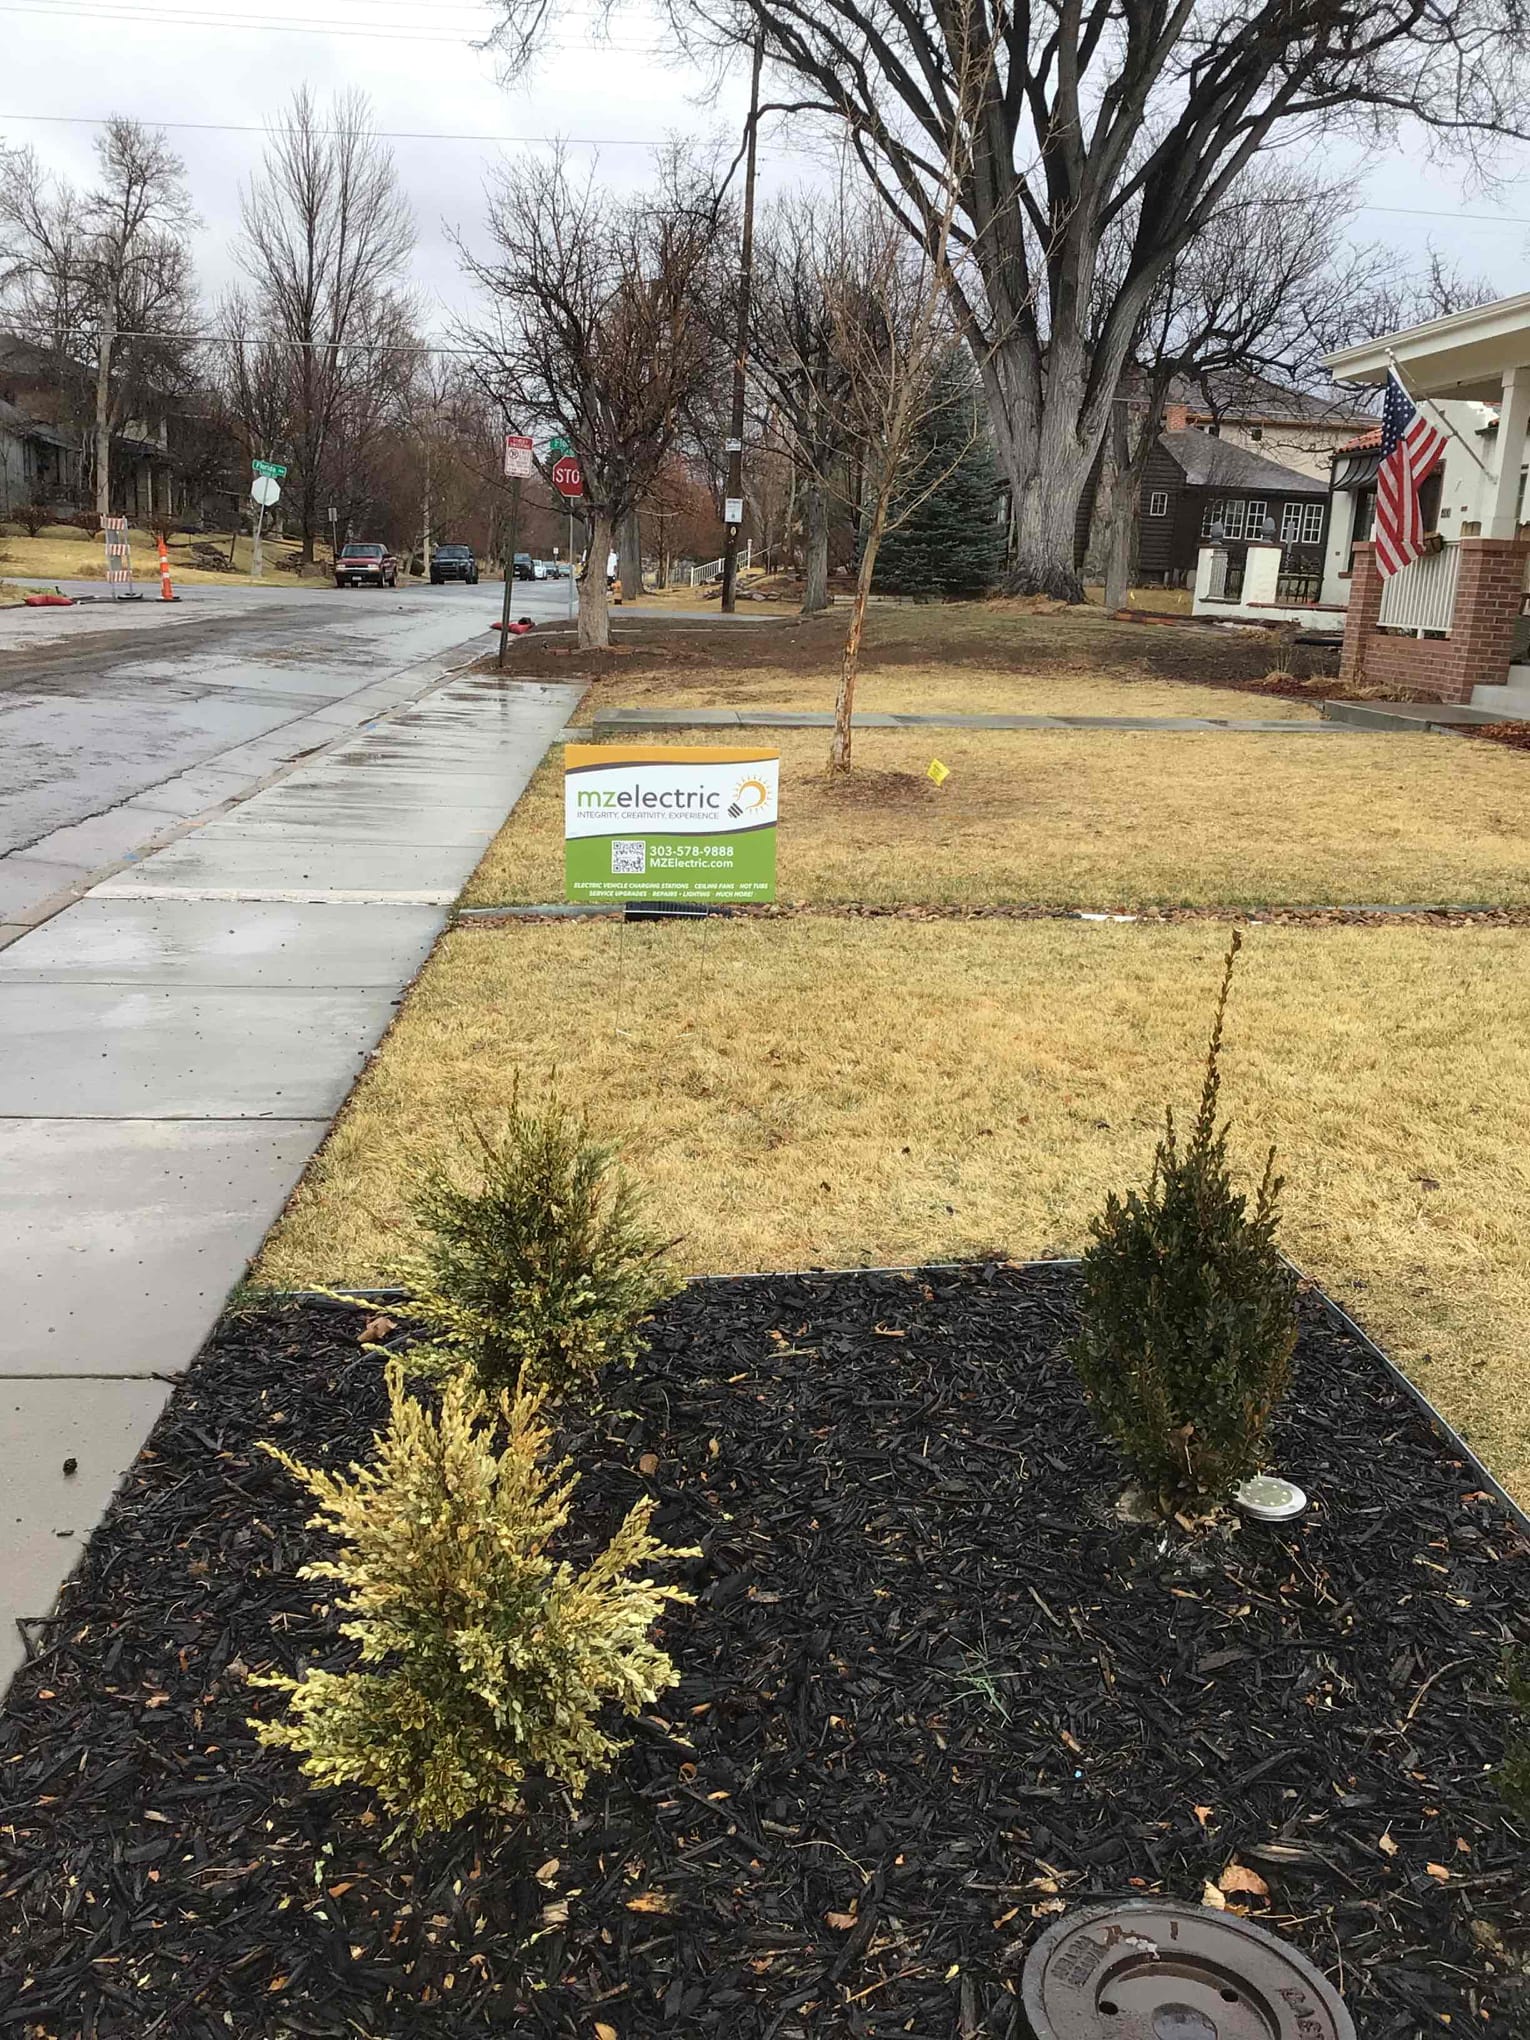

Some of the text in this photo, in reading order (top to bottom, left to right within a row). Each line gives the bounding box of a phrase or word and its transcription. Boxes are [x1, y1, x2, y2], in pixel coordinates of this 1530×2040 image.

[555, 468, 580, 485] STO
[577, 784, 721, 809] mzelectric
[576, 811, 620, 820] INTEGRITY,
[668, 811, 720, 820] EXPERIENCE
[649, 846, 734, 857] 303-578-9888
[649, 857, 734, 868] MZElectric.com
